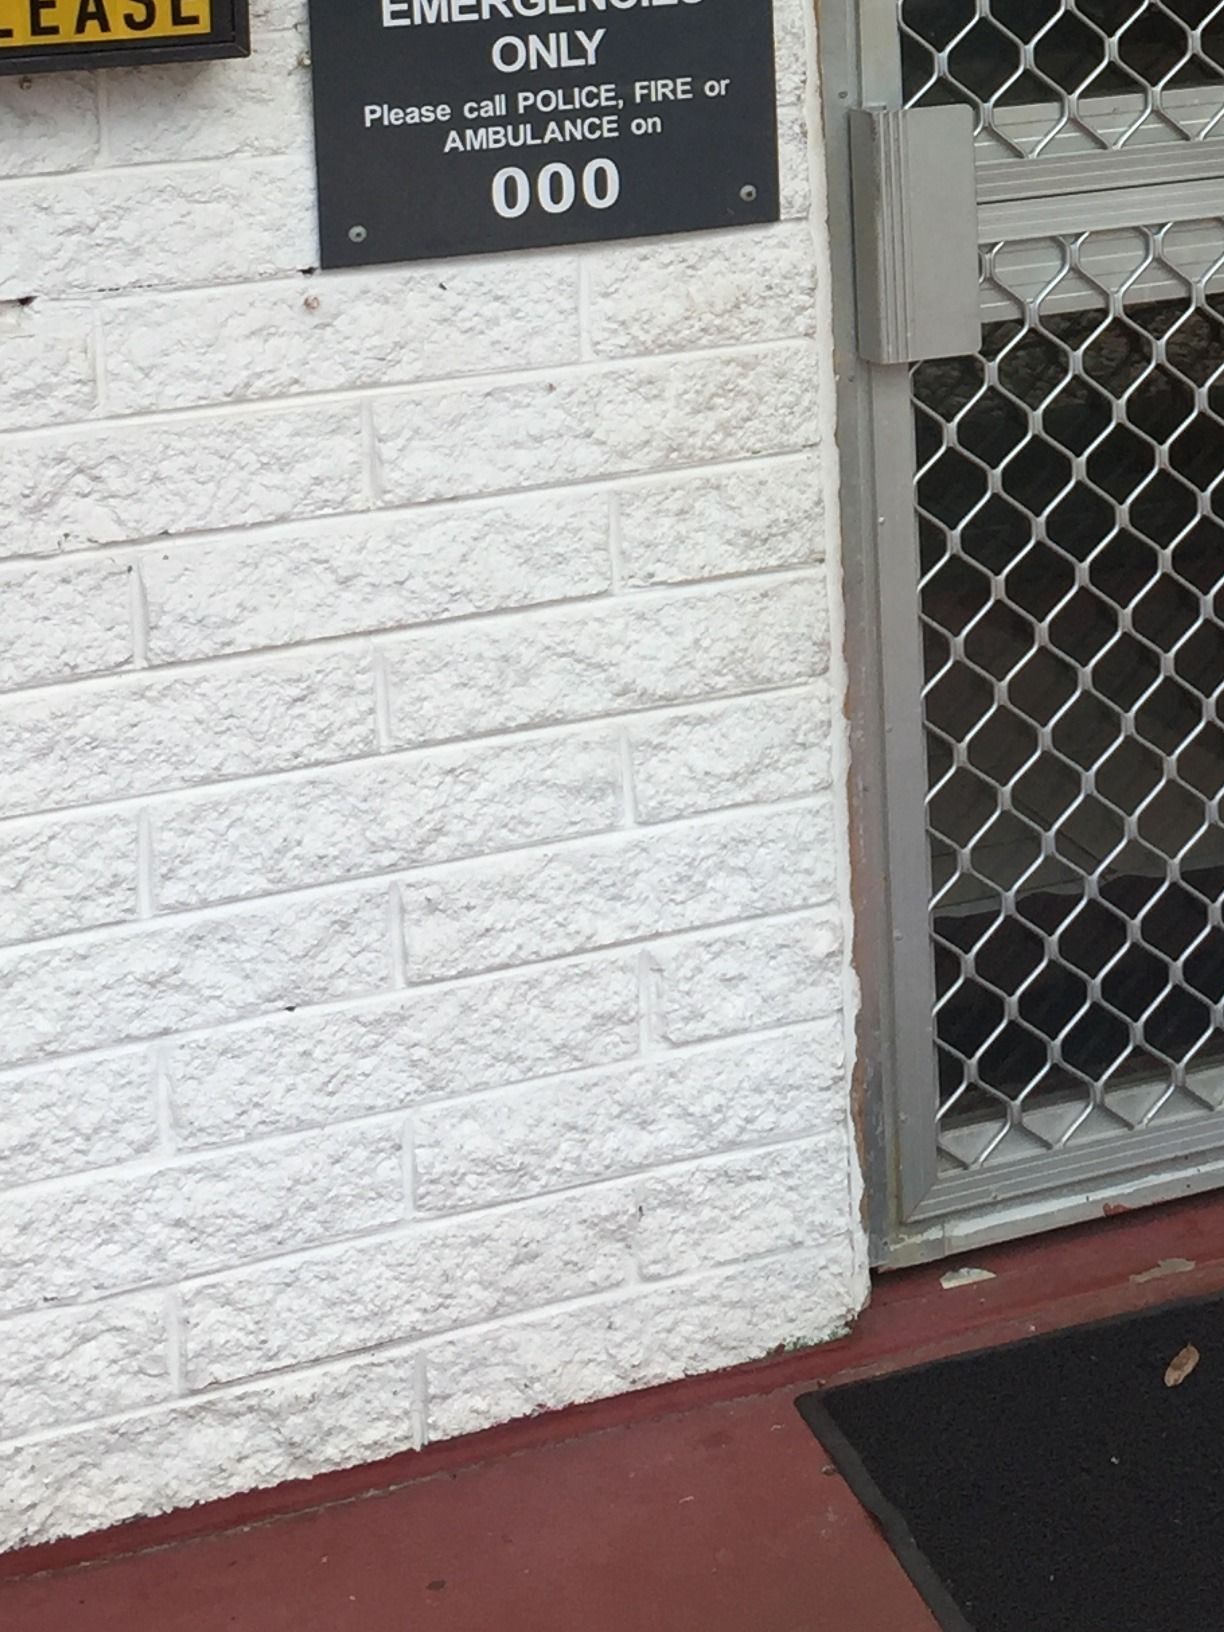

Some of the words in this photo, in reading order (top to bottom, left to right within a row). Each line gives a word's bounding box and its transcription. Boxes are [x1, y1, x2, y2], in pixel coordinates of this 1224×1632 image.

[491, 28, 607, 73] ONLY
[364, 102, 452, 128] Please
[463, 93, 507, 120] call
[518, 82, 625, 115] POLICE,
[634, 77, 694, 104] FIRE
[704, 77, 730, 98] or
[443, 116, 619, 153] AMBULANCE
[631, 116, 662, 136] on
[492, 157, 621, 219] 000
